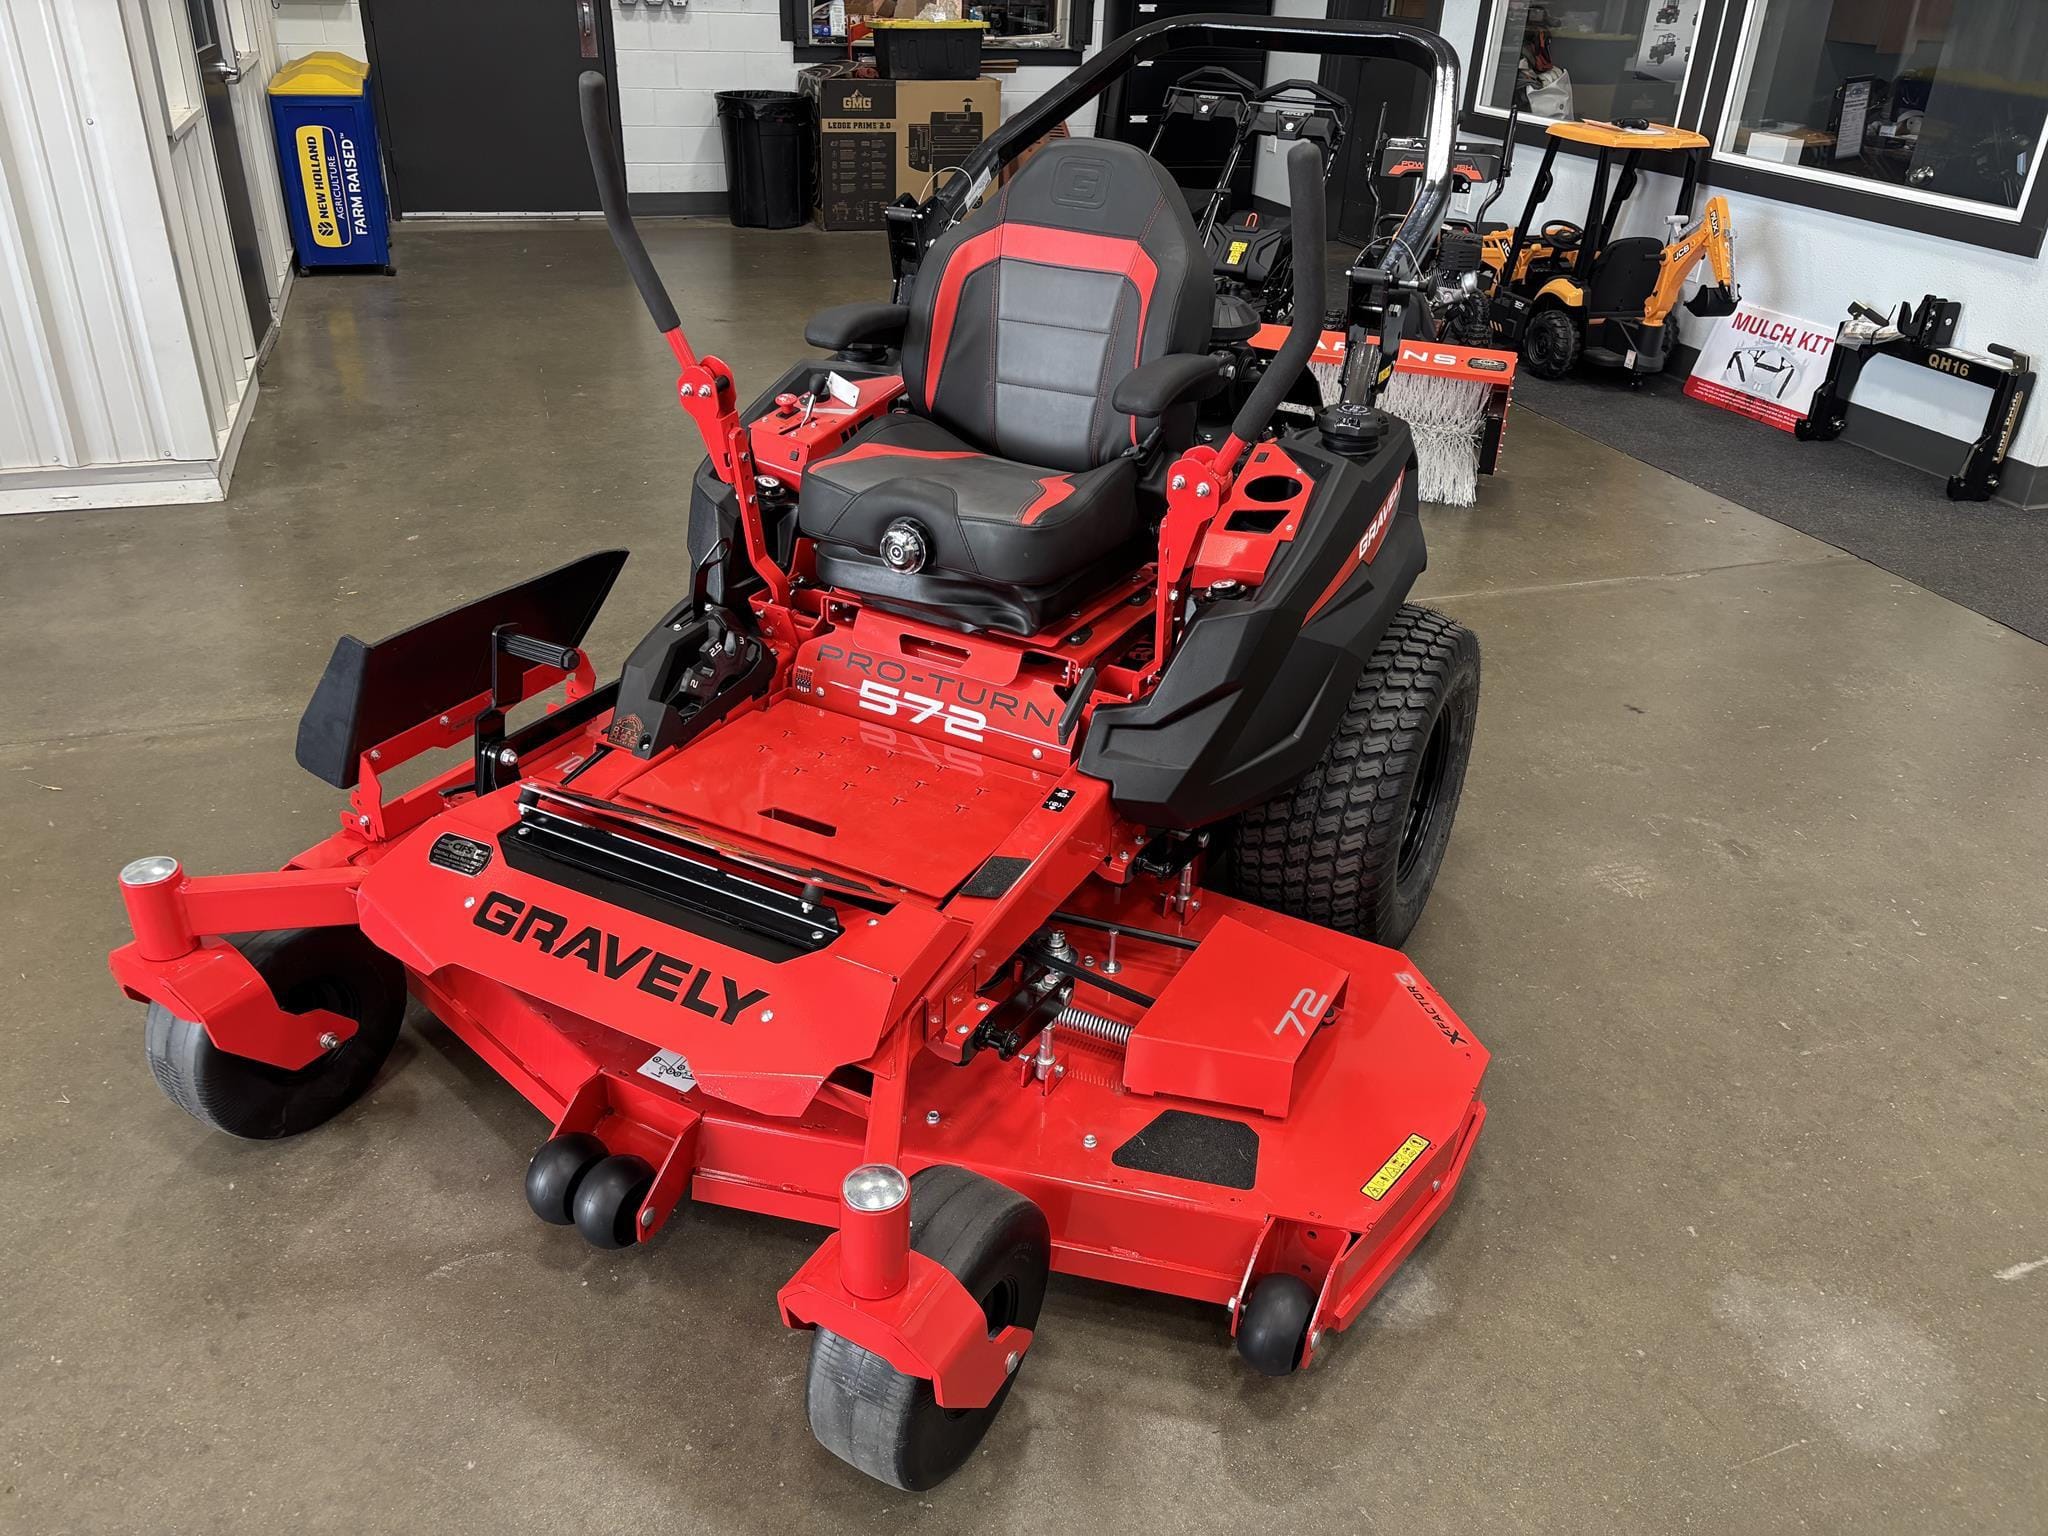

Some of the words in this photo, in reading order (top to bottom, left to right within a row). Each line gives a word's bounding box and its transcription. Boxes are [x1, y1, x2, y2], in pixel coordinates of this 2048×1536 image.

[843, 97, 872, 109] GMG
[853, 121, 876, 129] PRIME
[306, 136, 324, 190] HOLLAND
[318, 192, 329, 219] NEW
[327, 155, 345, 220] AGRICULTURE
[350, 196, 367, 235] FARM
[1501, 239, 1511, 257] JC
[1674, 243, 1690, 261] JCB
[1731, 311, 1797, 345] MULCH
[1797, 331, 1834, 355] KIT
[1928, 353, 1971, 377] QH16
[816, 643, 1055, 727] PRO-TURN
[472, 891, 771, 1026] GRAVELY
[1273, 987, 1329, 1037] 72
[1406, 985, 1469, 1046] X-FACTOR
